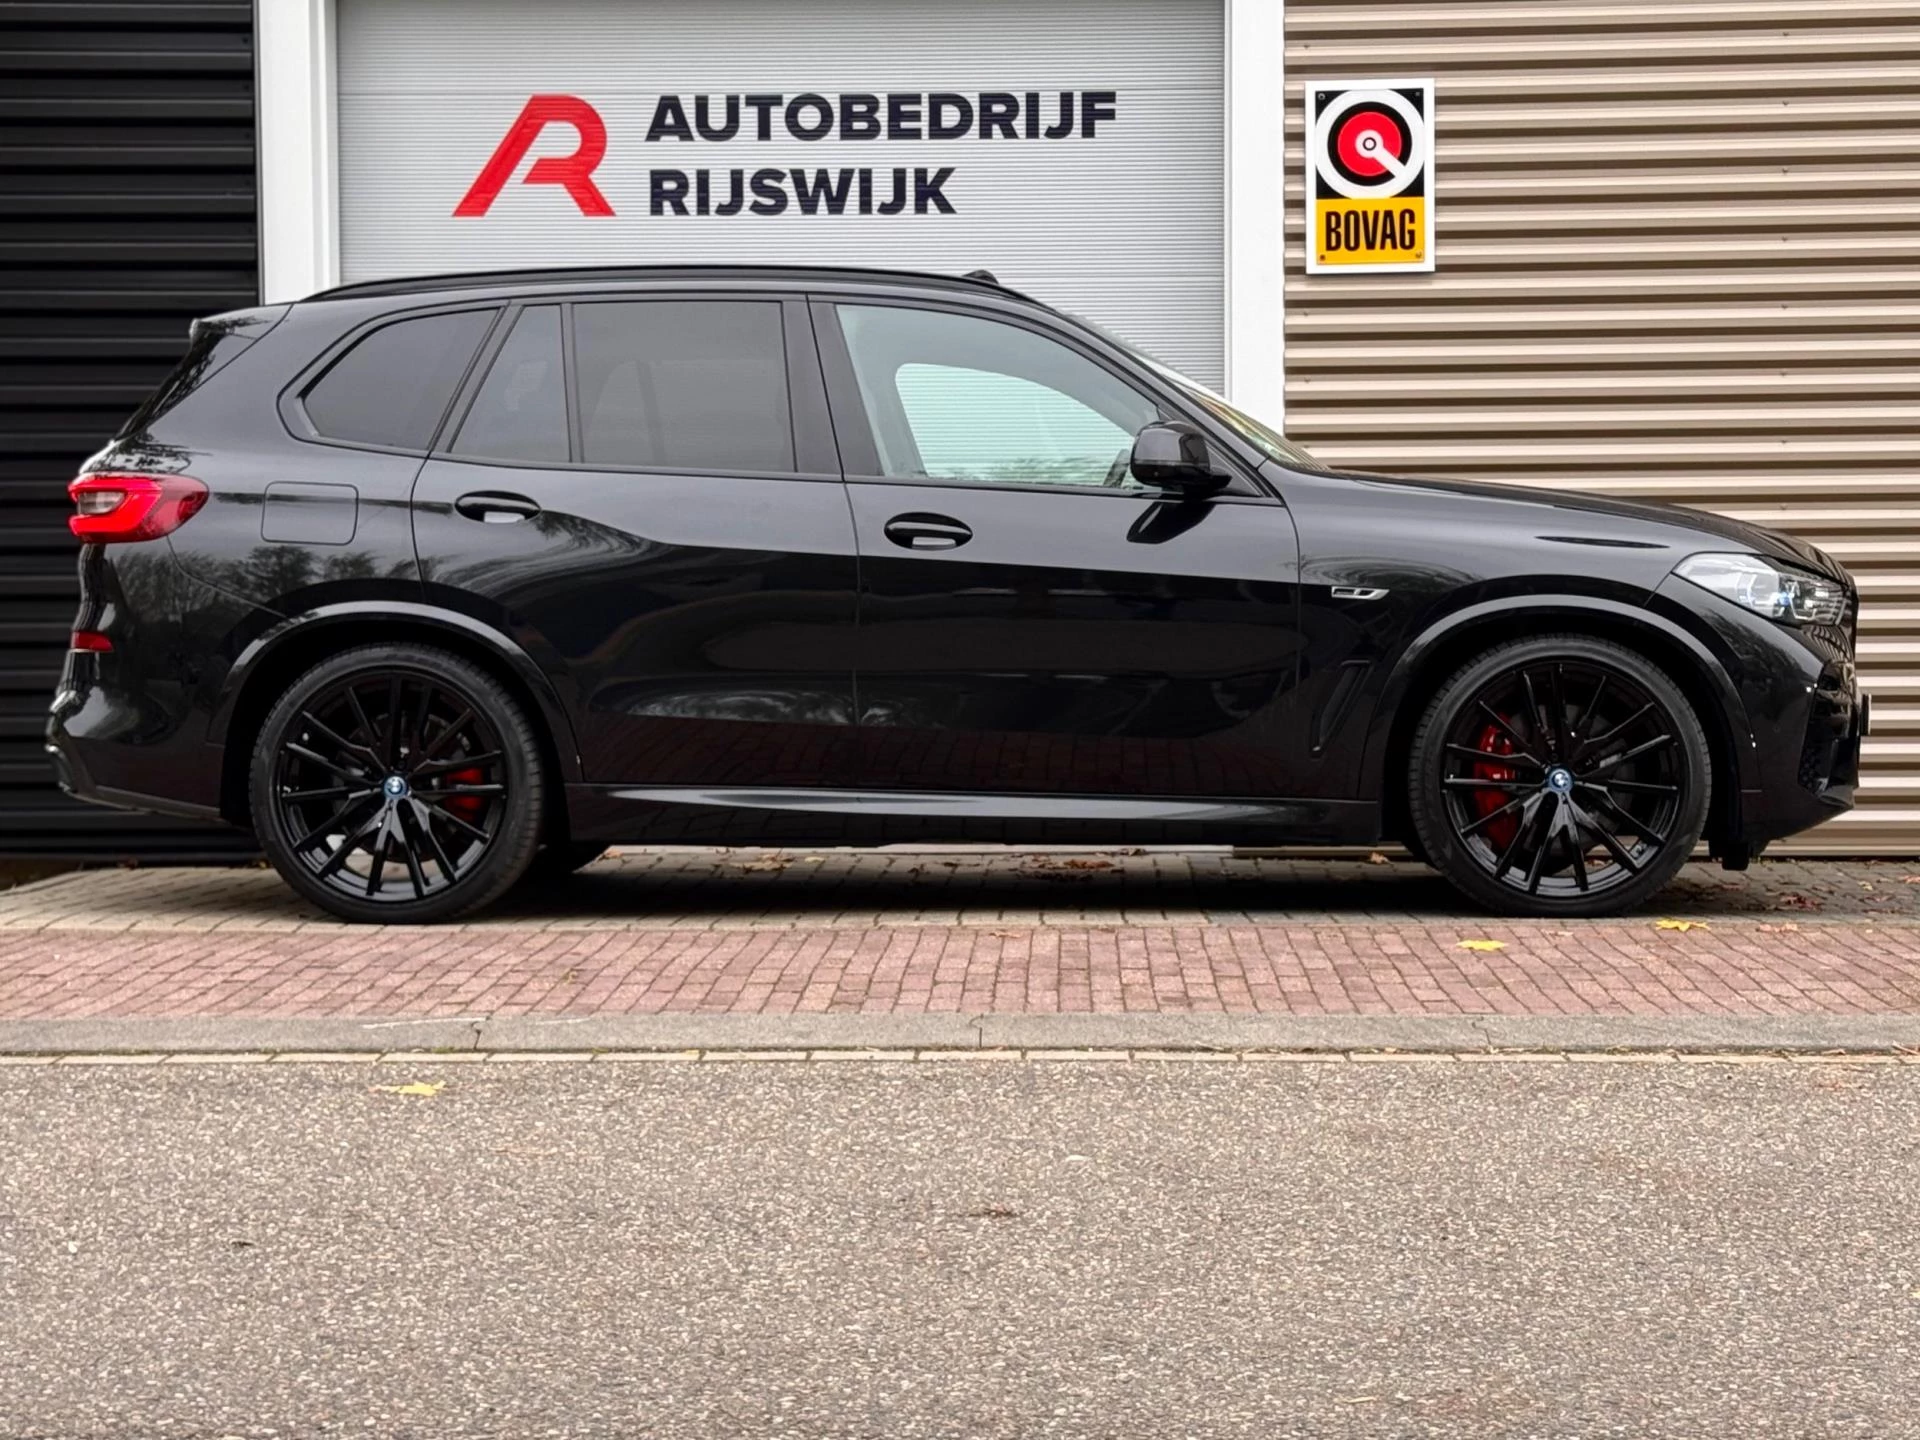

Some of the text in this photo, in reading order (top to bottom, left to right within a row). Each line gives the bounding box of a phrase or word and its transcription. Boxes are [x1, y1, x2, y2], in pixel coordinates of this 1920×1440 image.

[645, 91, 1117, 142] AUTOBEDRIJF
[649, 167, 957, 216] RIJSWIJK
[1325, 208, 1416, 252] BOVAG
